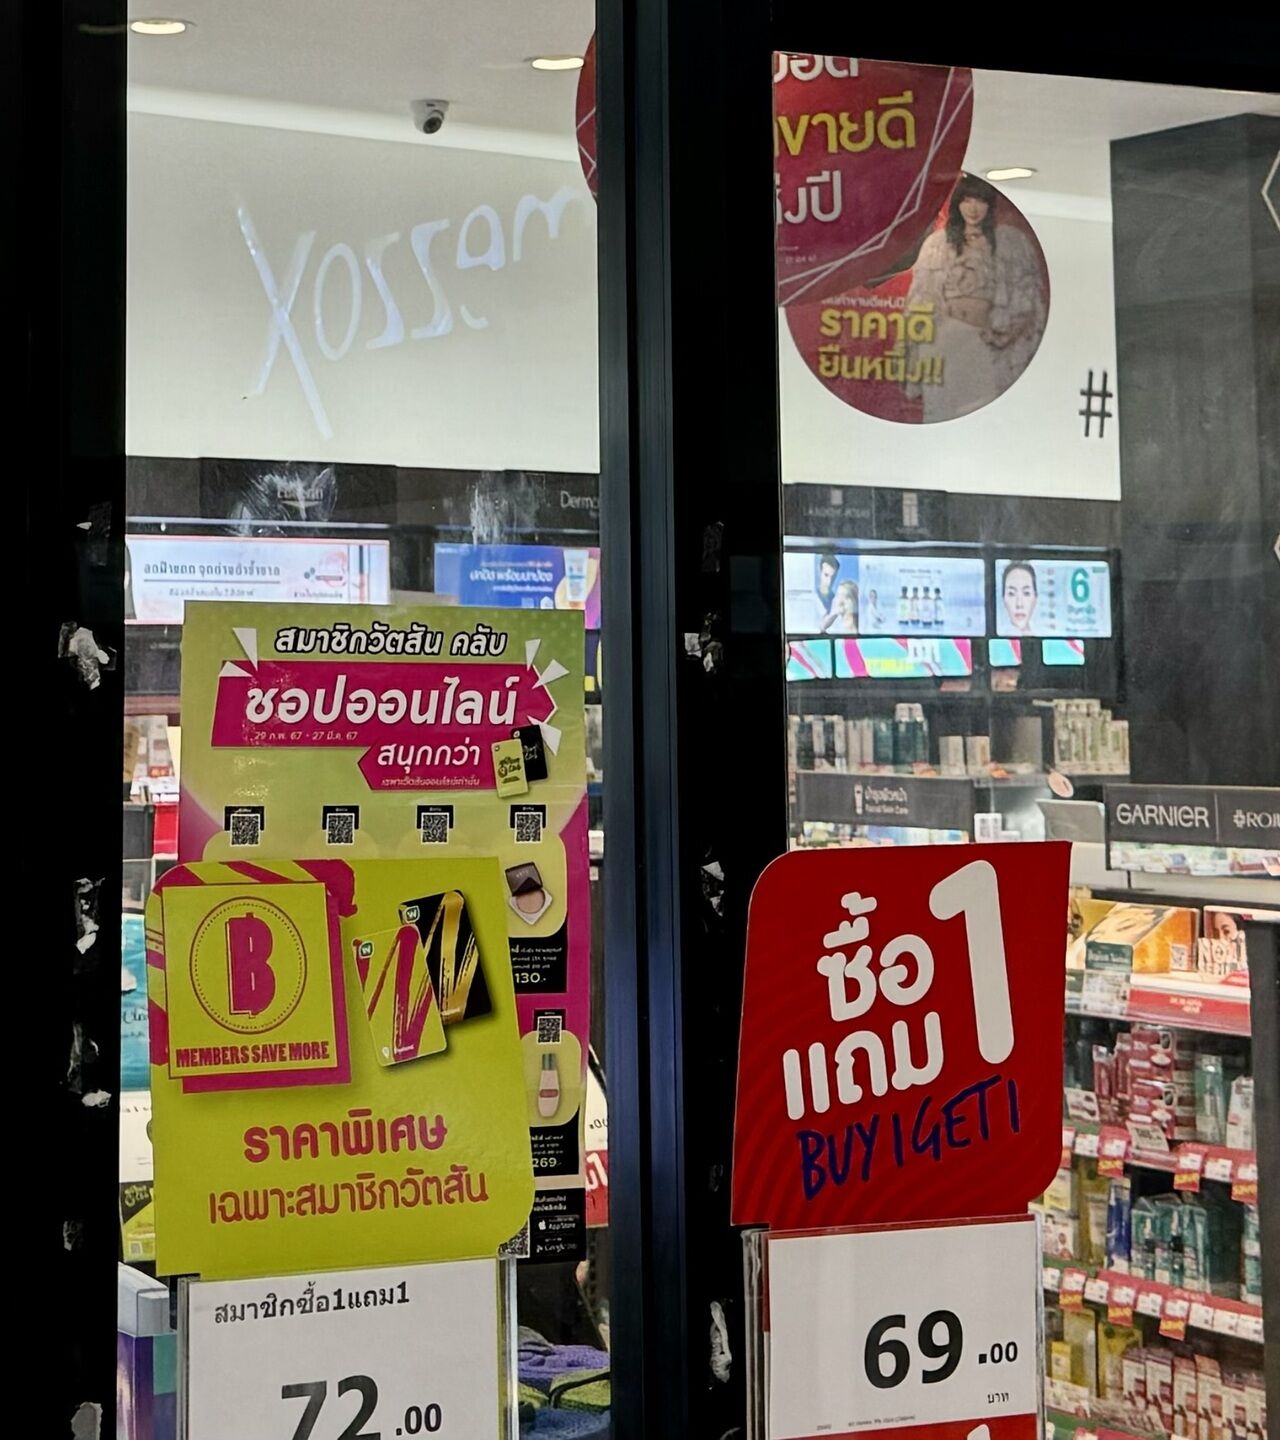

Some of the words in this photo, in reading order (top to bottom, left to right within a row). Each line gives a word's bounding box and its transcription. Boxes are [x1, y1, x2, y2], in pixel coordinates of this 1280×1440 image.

[820, 303, 935, 344] ราคาดี
[275, 622, 443, 656] สมาชิกวัตสัน
[449, 624, 508, 657] คลับ
[245, 674, 520, 726] ชอปออนไลน์
[290, 731, 302, 741] 67
[312, 731, 324, 741] 27
[346, 731, 358, 741] 67
[377, 737, 481, 773] สนุกกว่า
[1116, 803, 1209, 829] GARNIER
[817, 892, 934, 1022] ซื้อ
[929, 861, 1014, 1064] 1
[176, 1045, 249, 1068] MEMBERS
[252, 1044, 287, 1063] SAVE
[288, 1041, 330, 1060] MORE
[783, 1012, 943, 1121] แถม
[243, 1109, 448, 1163] ราคาพิเศษ
[209, 1165, 488, 1225] เฉพาะสมาชิกวัตสัน
[214, 1281, 411, 1324] สมาชิกซื้อ1แถม1
[987, 1392, 1009, 1404] บาท
